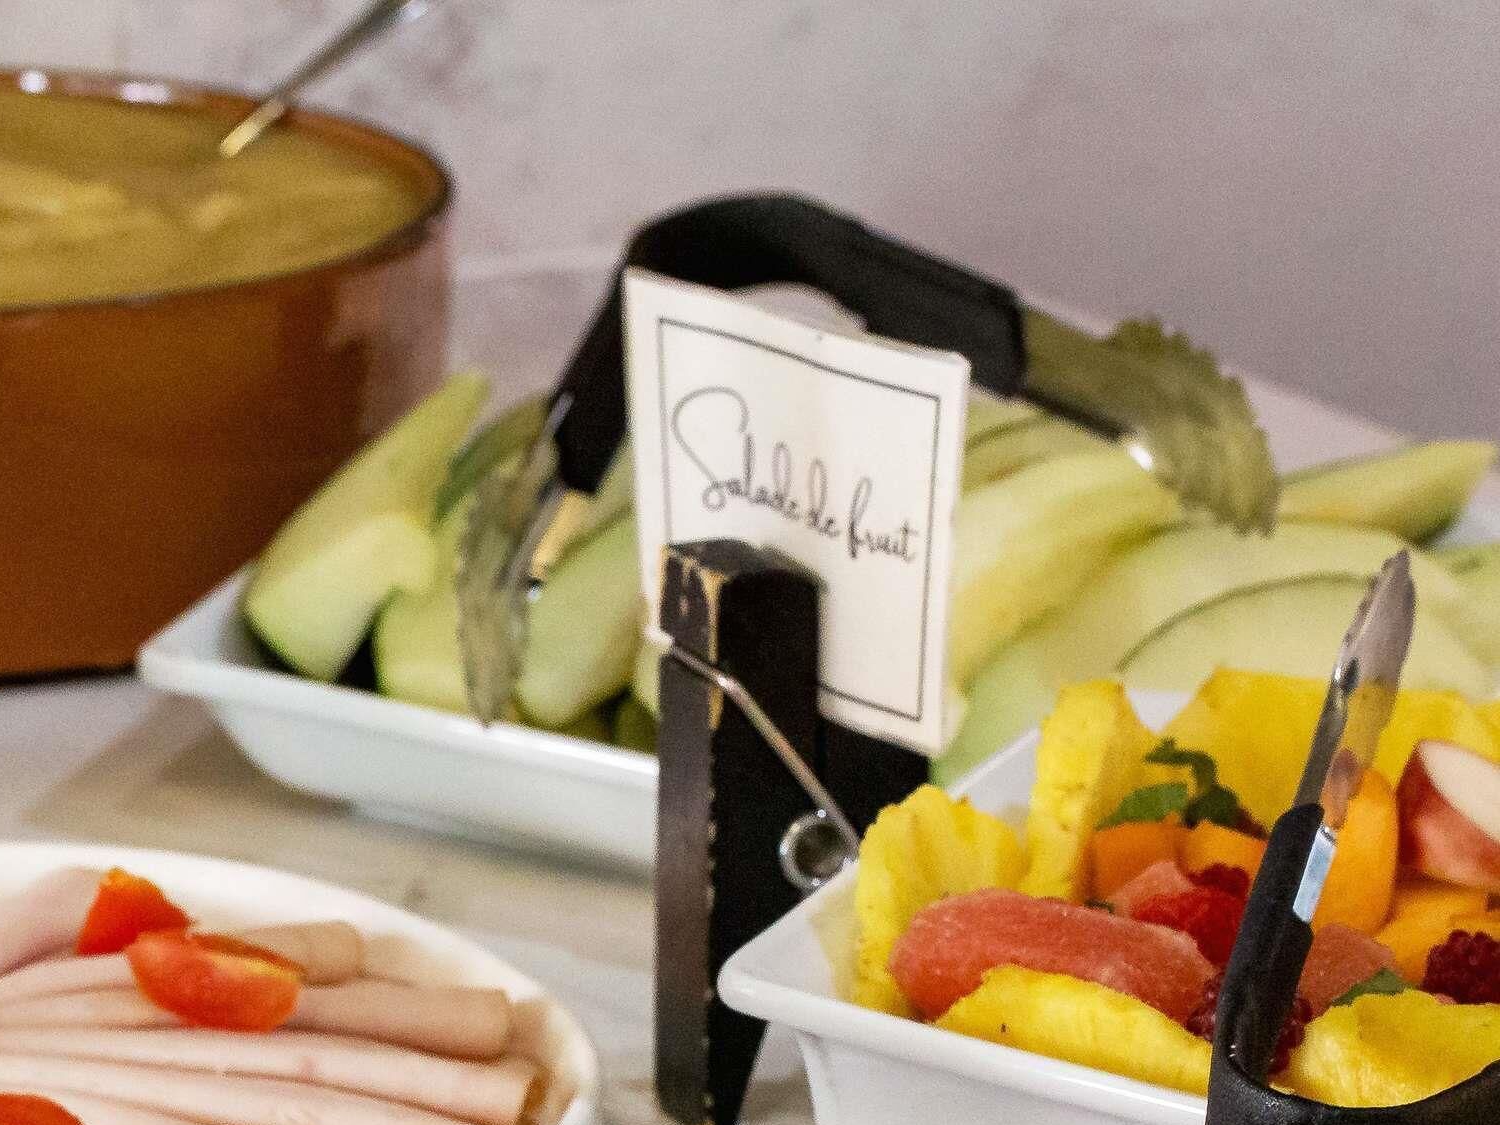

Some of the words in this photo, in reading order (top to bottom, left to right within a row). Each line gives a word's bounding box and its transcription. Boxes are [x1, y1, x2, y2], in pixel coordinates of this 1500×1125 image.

[670, 384, 801, 521] Salade
[803, 456, 842, 538] de
[848, 475, 919, 562] fruit
